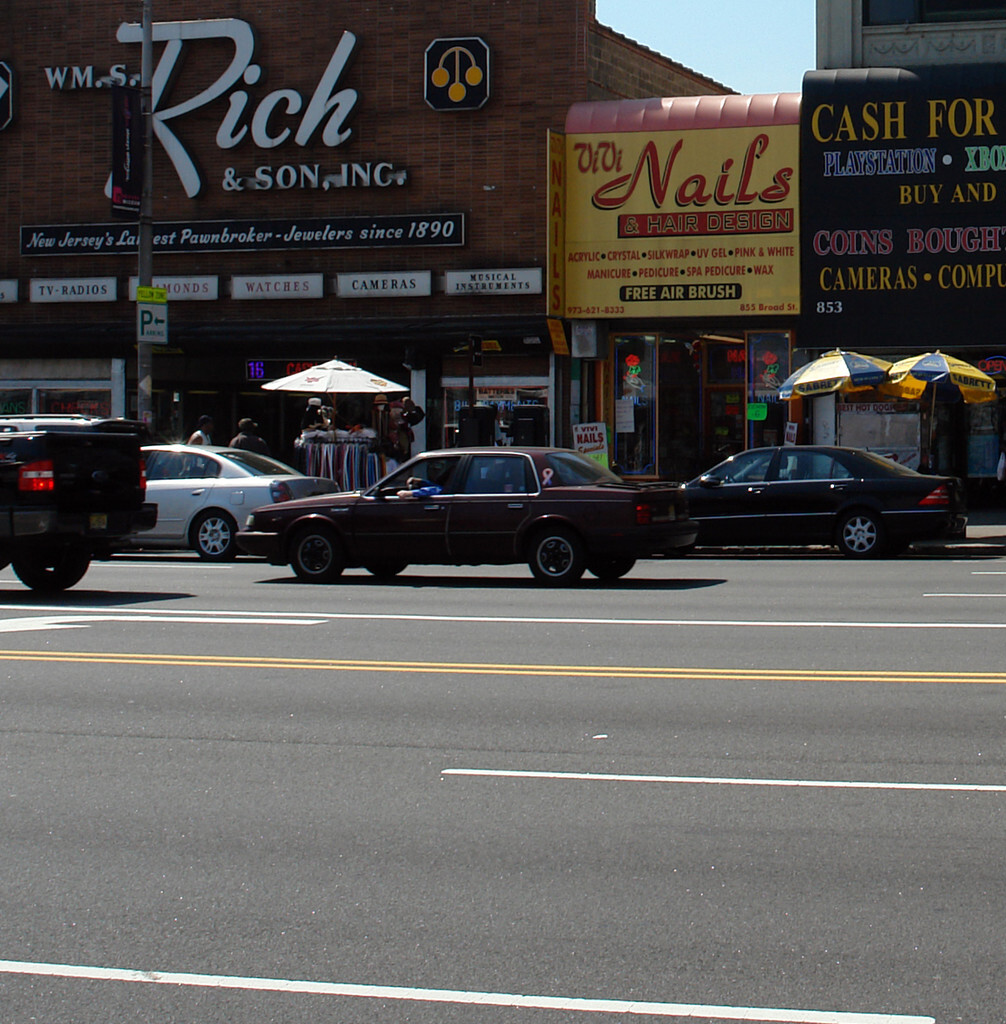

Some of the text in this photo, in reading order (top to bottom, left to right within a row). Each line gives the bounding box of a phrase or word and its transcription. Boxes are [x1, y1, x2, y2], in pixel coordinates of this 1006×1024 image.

[44, 65, 103, 90] WM.
[104, 18, 359, 199] Rich
[811, 101, 907, 144] CASH
[926, 97, 999, 138] FOR
[592, 133, 794, 210] Nails
[823, 147, 937, 177] PLAYSTATION
[221, 161, 407, 192] & SON, INC.
[899, 183, 944, 206] BUY
[951, 181, 998, 204] AND
[623, 211, 791, 233] & HAIR DESIGN
[26, 231, 57, 249] New
[57, 230, 114, 251] Jersey's
[115, 228, 177, 246] Laest
[359, 224, 404, 241] since
[407, 220, 455, 240] 1890
[551, 160, 562, 311] NAILS
[812, 229, 894, 256] COINS
[568, 248, 600, 262] ACRYLIC
[607, 250, 641, 261] CRYSTAL
[647, 248, 690, 260] SILKWRAP
[697, 248, 709, 258] UV
[711, 248, 728, 259] GEL
[734, 247, 756, 258] PINK
[767, 246, 795, 257] WHITE
[470, 273, 517, 282] MUSICAL
[587, 264, 774, 280] MANICURE PEDICURE SPA PEDICURE WAX
[819, 265, 918, 292] CAMERAS
[38, 284, 108, 296] TV-RADIOS
[245, 280, 310, 293] WATCHES
[352, 278, 417, 291] CAMERAS
[456, 281, 530, 291] INSTRUMENTS
[624, 284, 736, 301] FREE AIR BRUSH
[567, 305, 625, 315] 973-621-8333
[739, 303, 756, 312] 855
[758, 302, 785, 312] Broad
[816, 300, 843, 314] 853
[576, 432, 605, 444] NAILS
